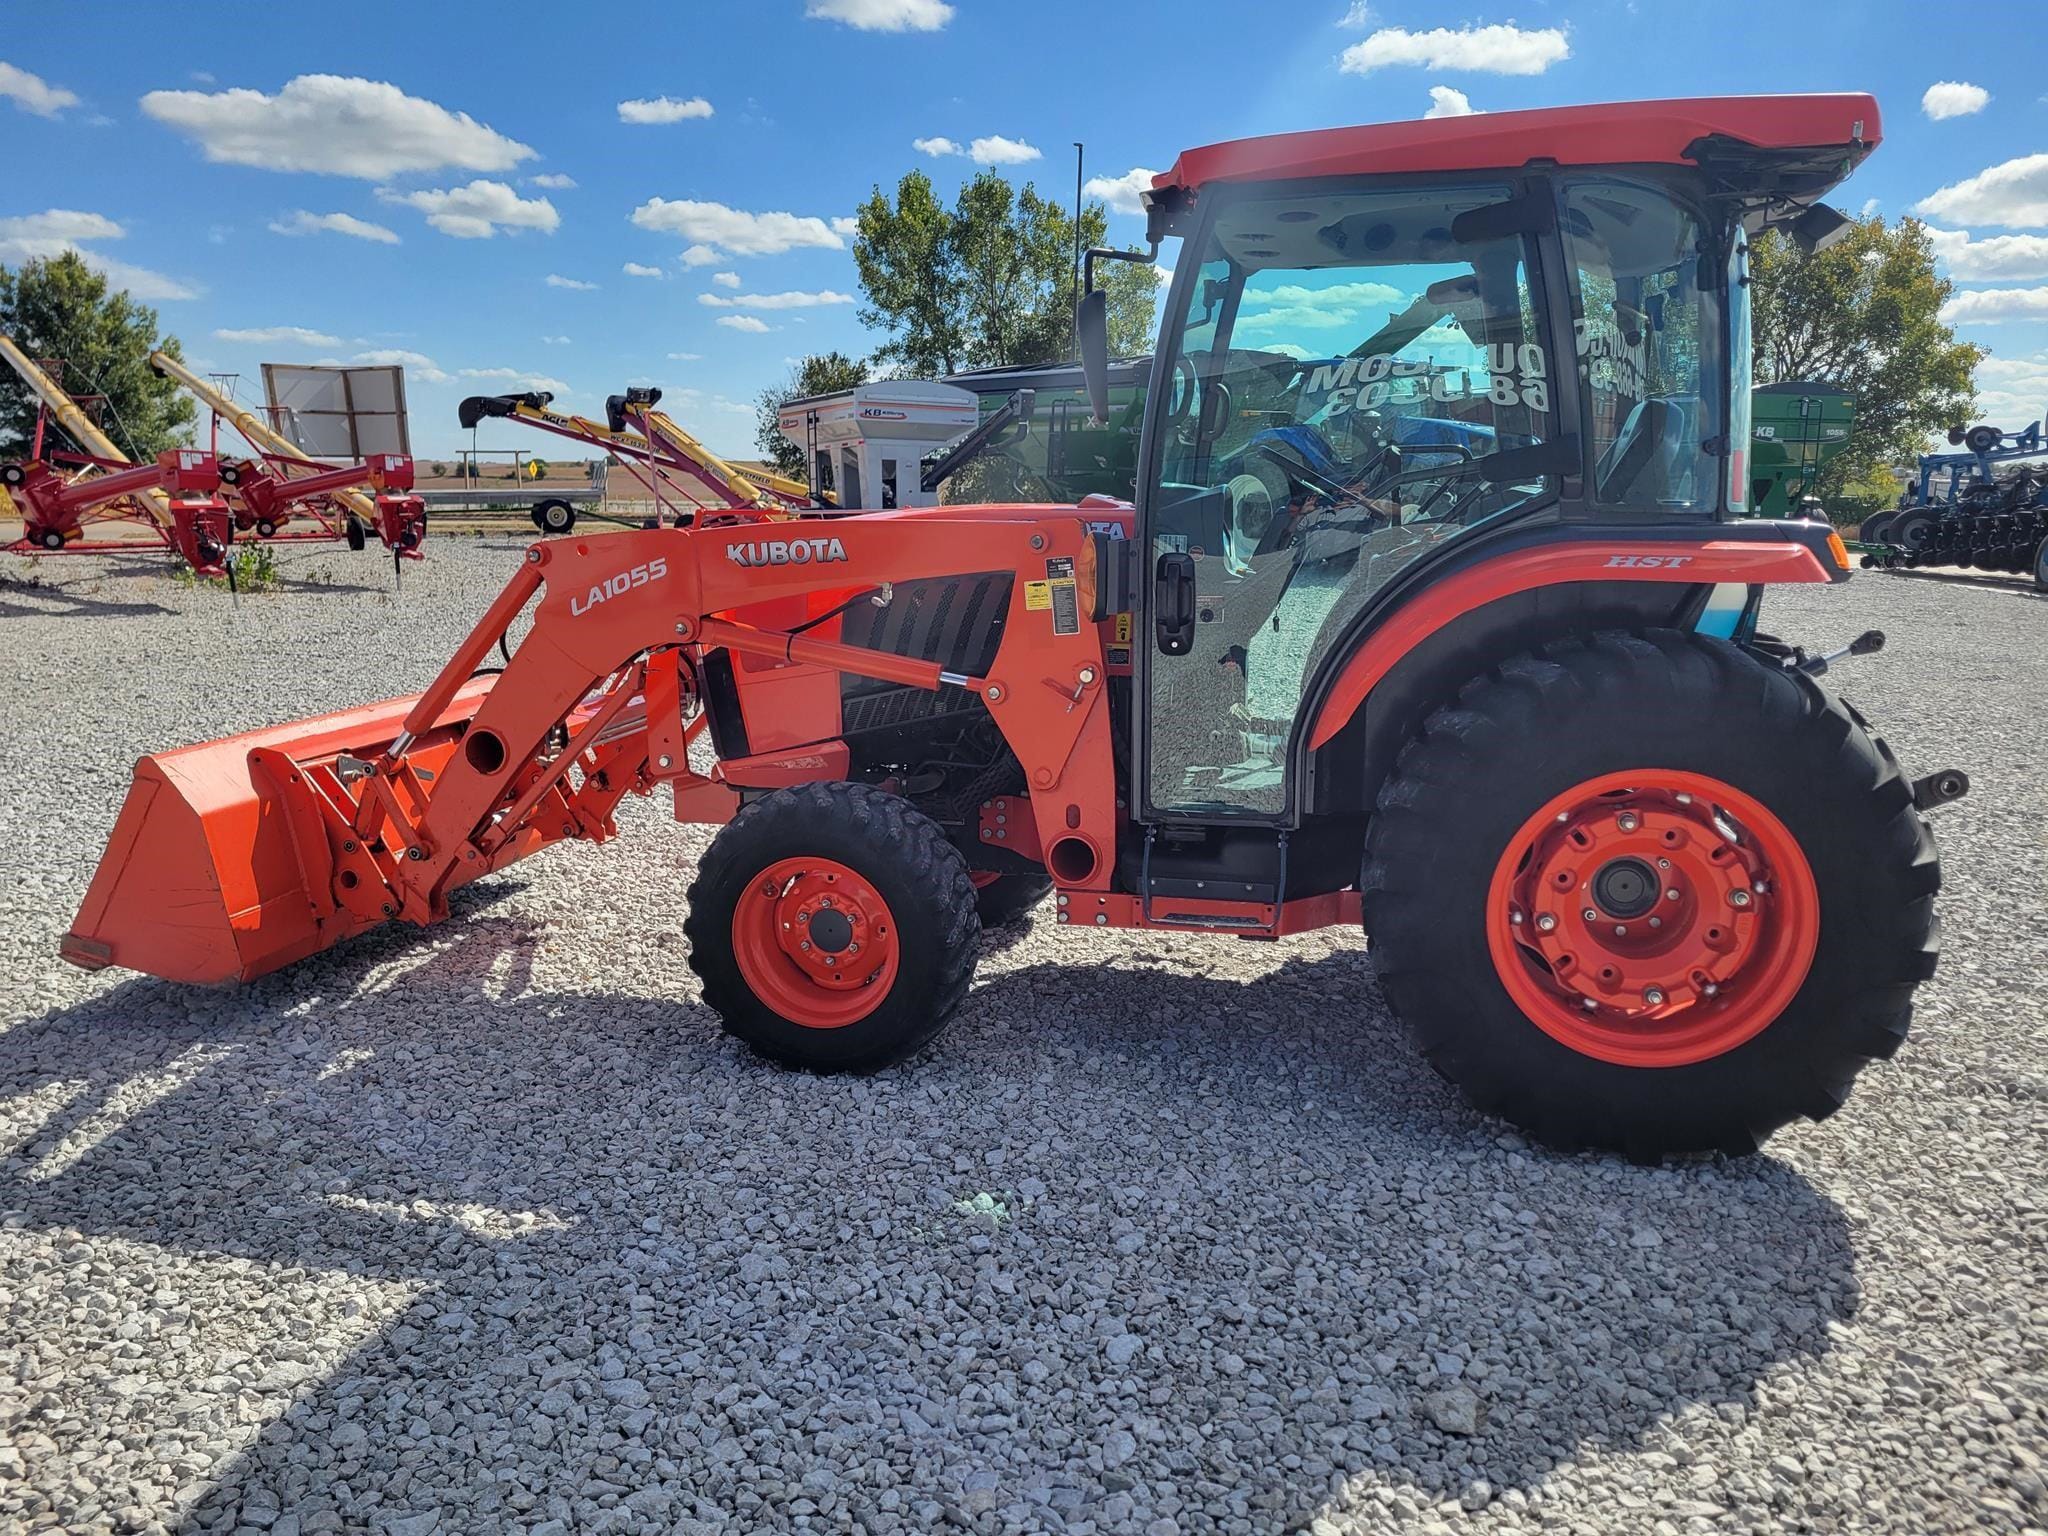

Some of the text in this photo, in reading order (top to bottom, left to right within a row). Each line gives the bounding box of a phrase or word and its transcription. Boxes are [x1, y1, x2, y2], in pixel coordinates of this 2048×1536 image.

[864, 408, 882, 417] KB
[1756, 426, 1775, 437] KB
[726, 537, 848, 567] KUBOTA
[1603, 556, 1693, 568] HST
[570, 557, 668, 617] LA1055
